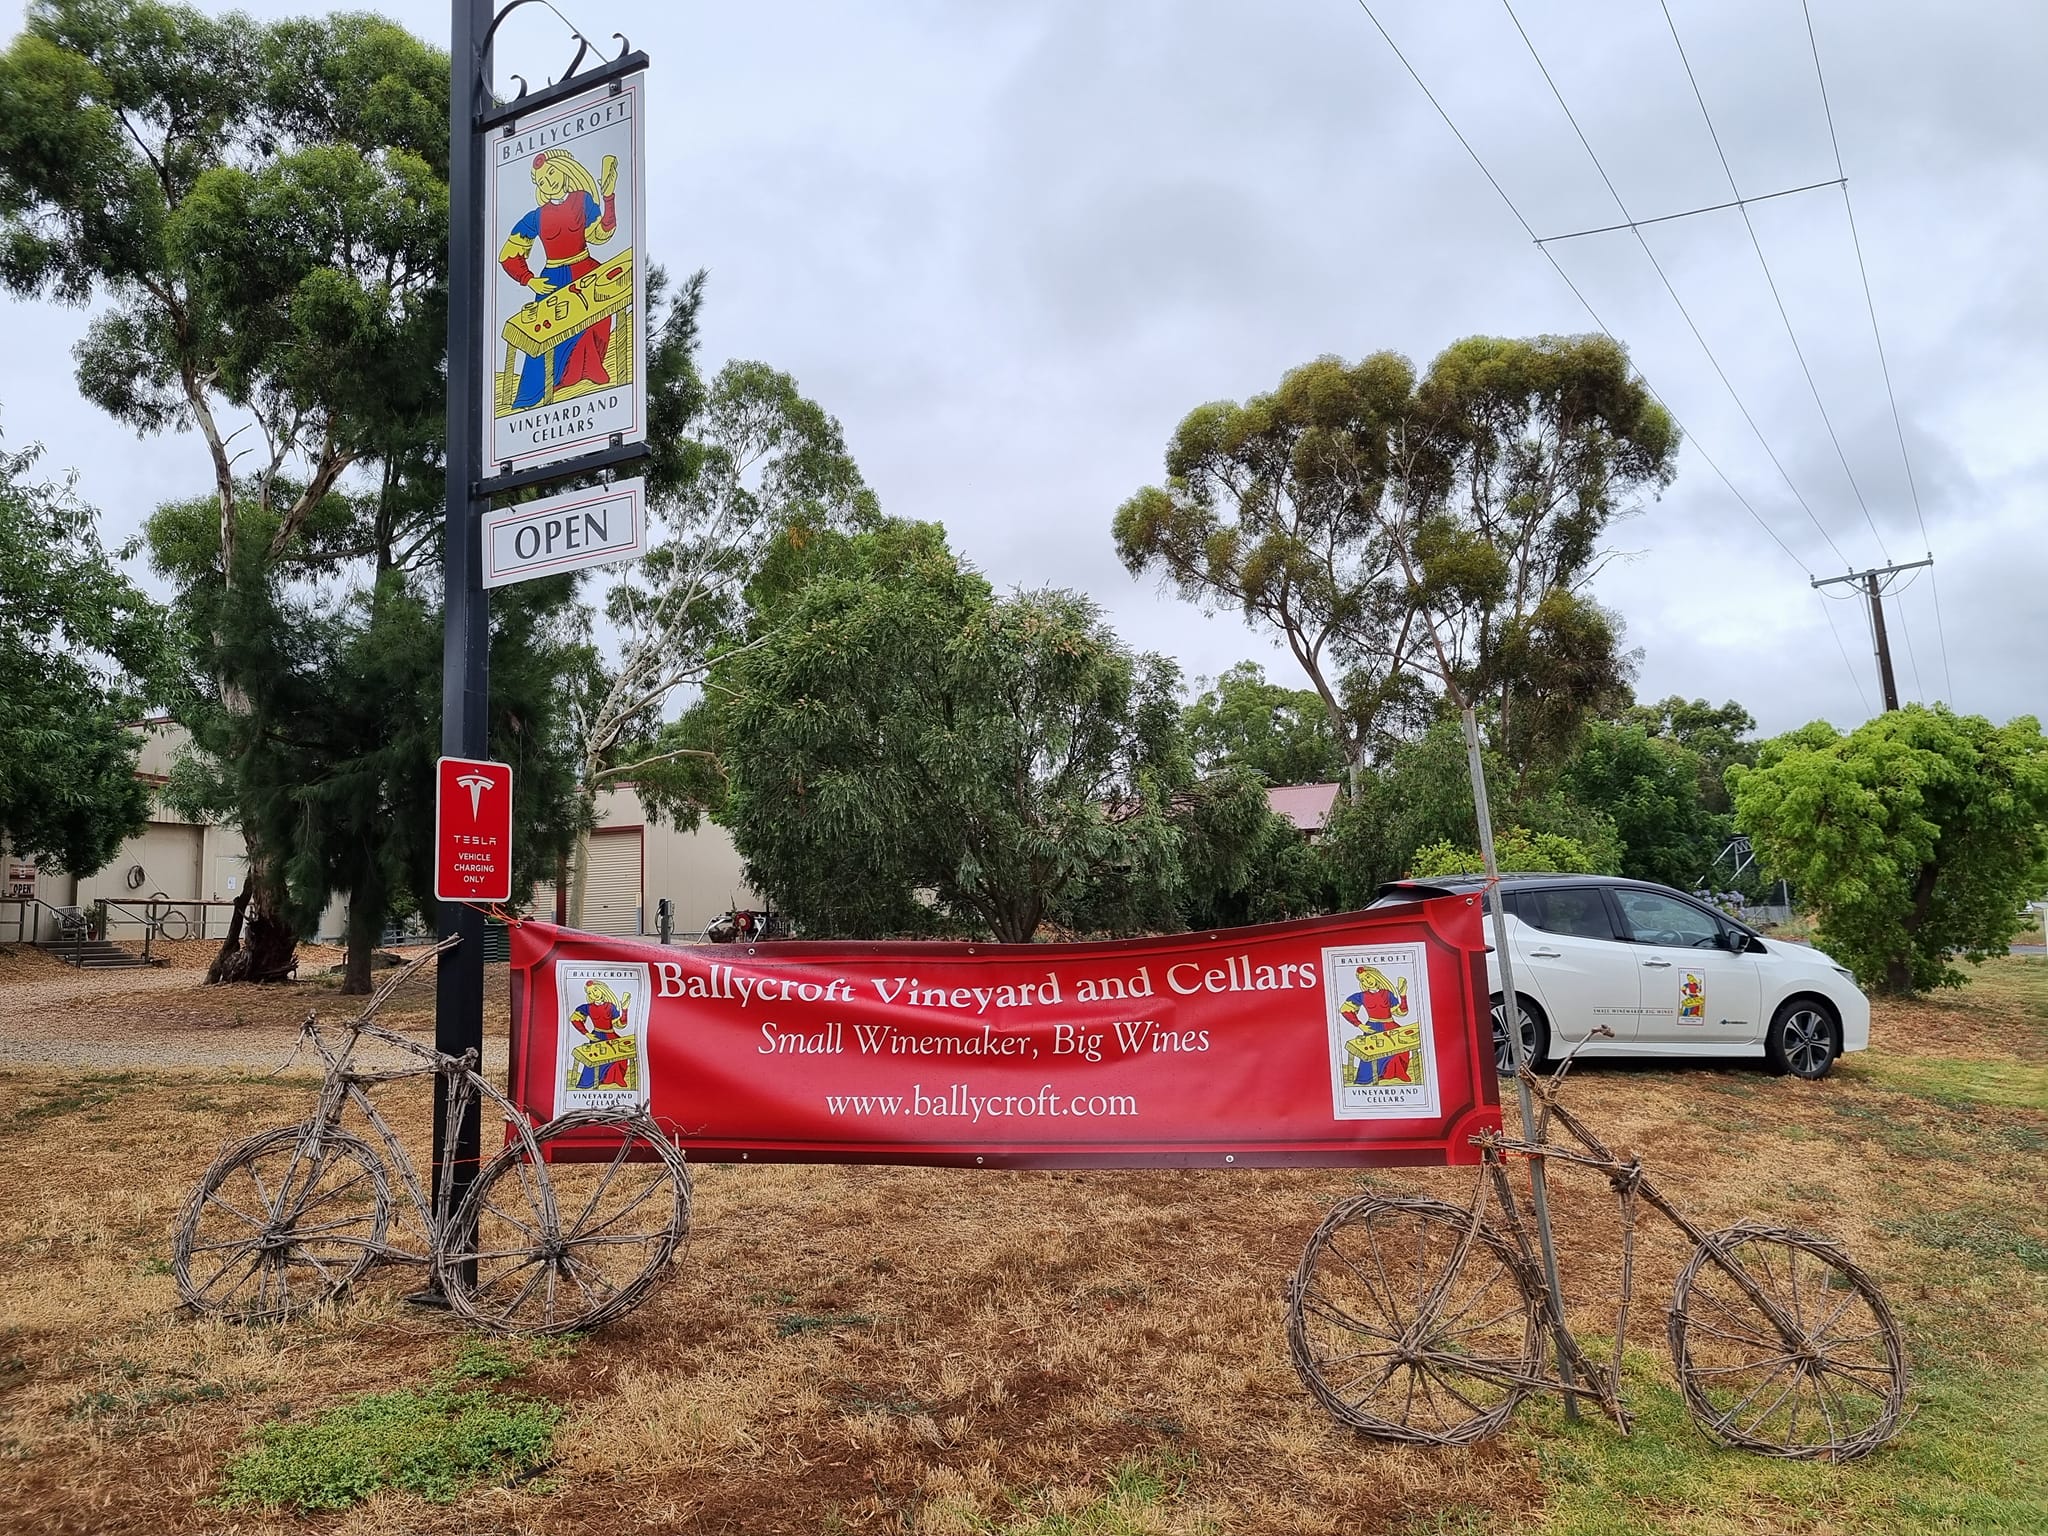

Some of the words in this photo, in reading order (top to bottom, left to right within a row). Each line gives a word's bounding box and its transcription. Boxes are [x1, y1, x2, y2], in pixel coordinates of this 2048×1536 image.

[502, 102, 626, 160] BALLYCROFT
[509, 405, 581, 434] VINEYARD
[587, 395, 618, 414] AND
[532, 418, 594, 443] CELLARS
[514, 509, 608, 560] OPEN
[453, 835, 497, 845] TESLA
[454, 863, 495, 872] CHARGING
[458, 853, 491, 862] VEHICLE
[13, 883, 32, 894] OPEN
[463, 875, 485, 883] ONLY
[1341, 955, 1406, 964] BALLYCROFT
[653, 962, 856, 1007] Ballycroft
[871, 972, 1063, 1015] Vineyard
[1075, 966, 1154, 1003] and
[1166, 954, 1317, 995] Cellars
[757, 1022, 843, 1055] Small
[853, 1024, 1039, 1060] Winemaker,
[1053, 1024, 1103, 1062] Big
[1112, 1021, 1209, 1055] Wines
[825, 1084, 1138, 1123] www.ballycroft.com
